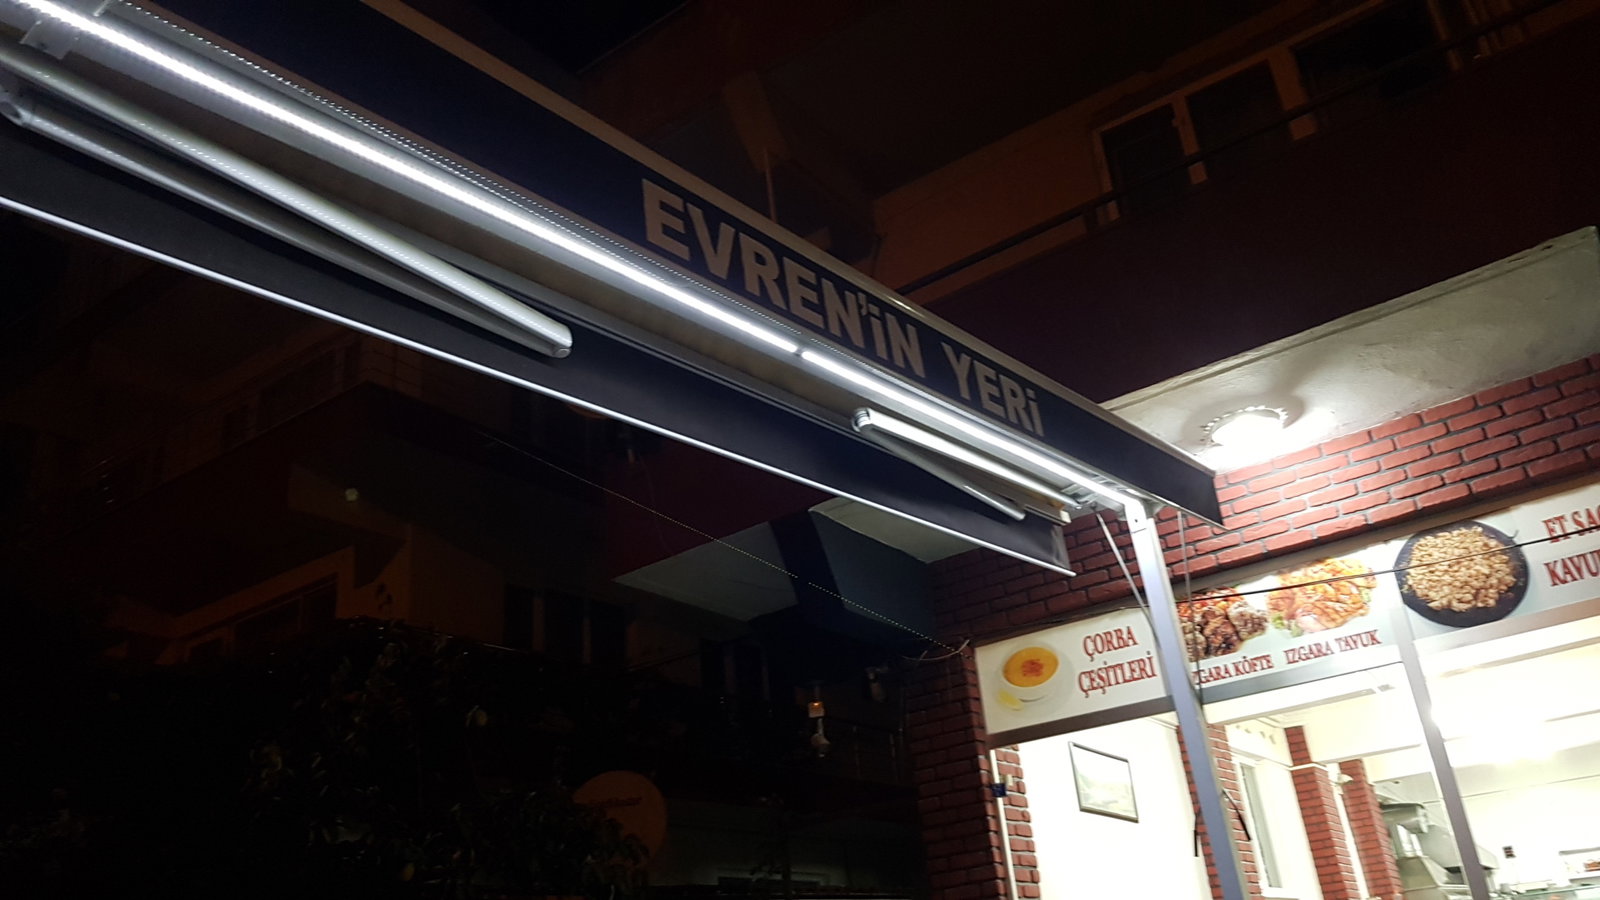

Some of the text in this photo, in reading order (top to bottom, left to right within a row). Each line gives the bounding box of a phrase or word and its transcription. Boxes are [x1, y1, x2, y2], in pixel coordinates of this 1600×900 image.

[1542, 504, 1600, 543] ET SA
[1544, 549, 1600, 586] KAVU
[1083, 626, 1138, 662] ÇORBA
[1284, 629, 1381, 665] IZGARA TAVUK
[1078, 650, 1157, 698] ÇEŞİTLERİ
[1232, 655, 1274, 676] KÖFTE
